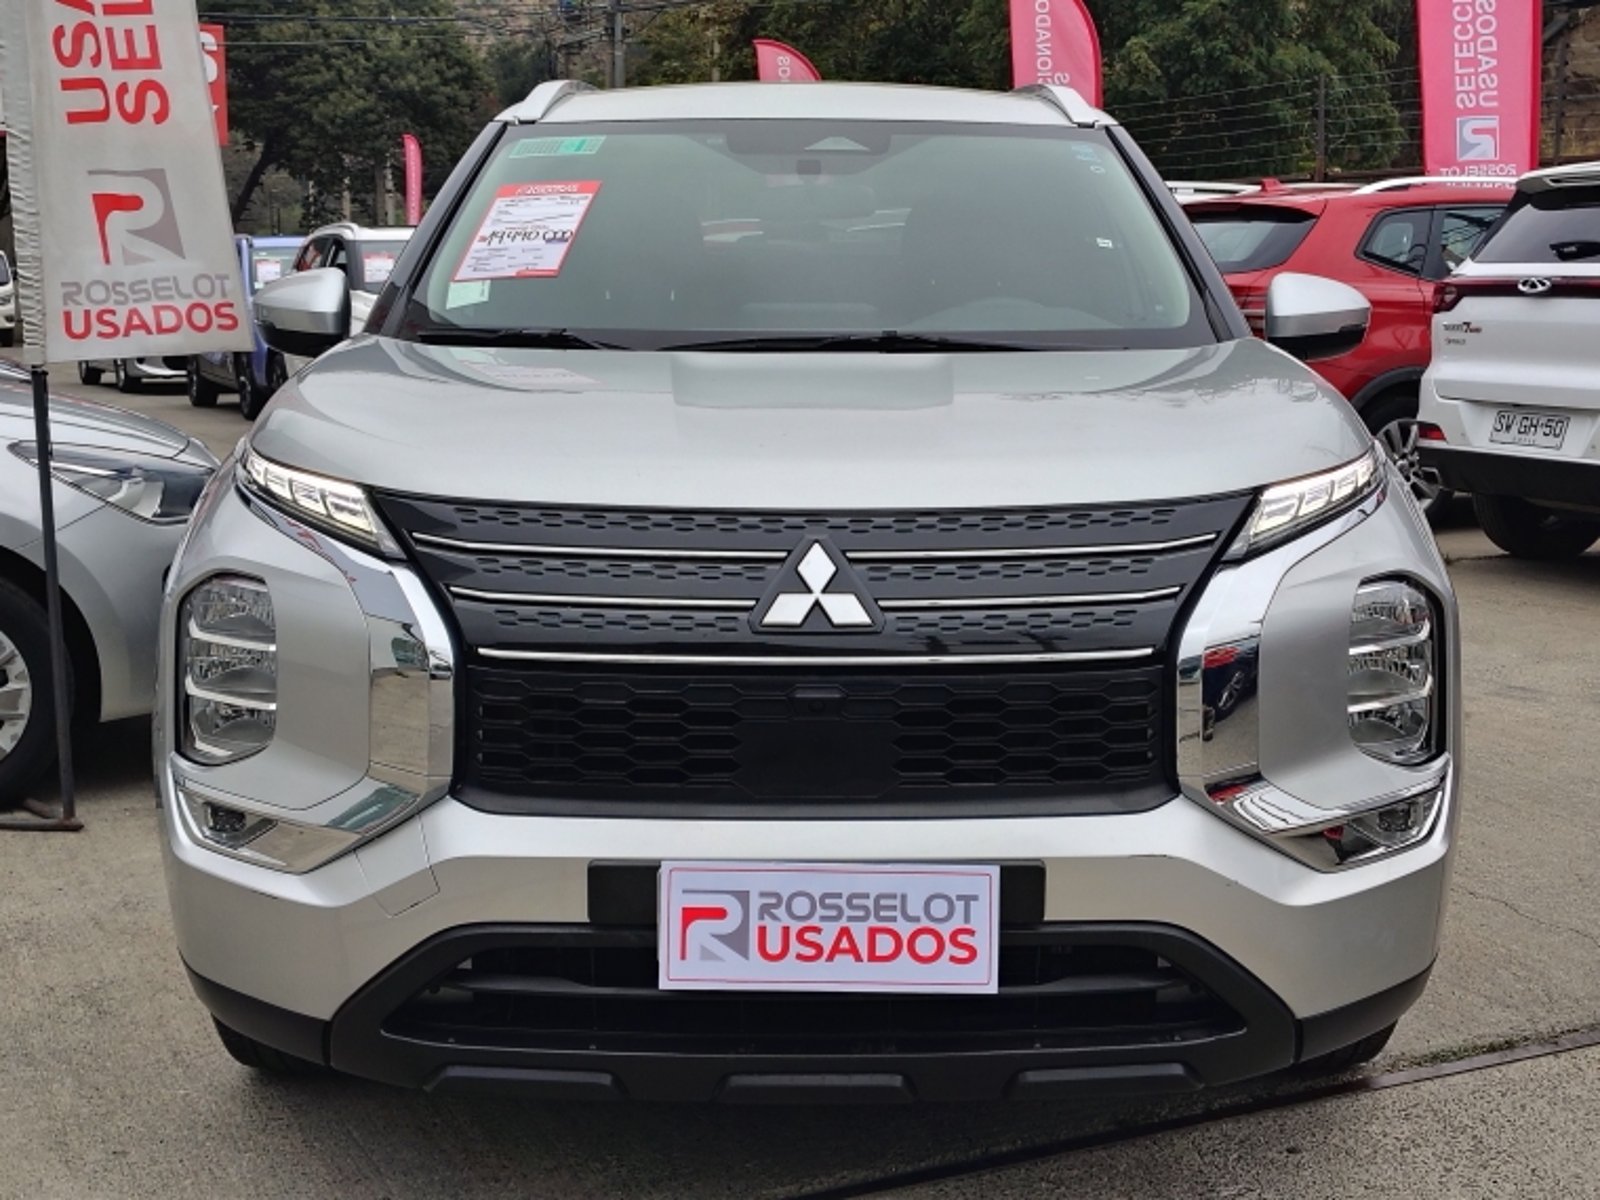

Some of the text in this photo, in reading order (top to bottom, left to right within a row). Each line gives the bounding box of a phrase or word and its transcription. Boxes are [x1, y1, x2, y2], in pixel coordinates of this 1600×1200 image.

[60, 273, 230, 307] ROSSELOT
[62, 302, 239, 340] USADOS
[758, 890, 979, 925] ROSSELOT
[757, 925, 978, 965] USADOS
